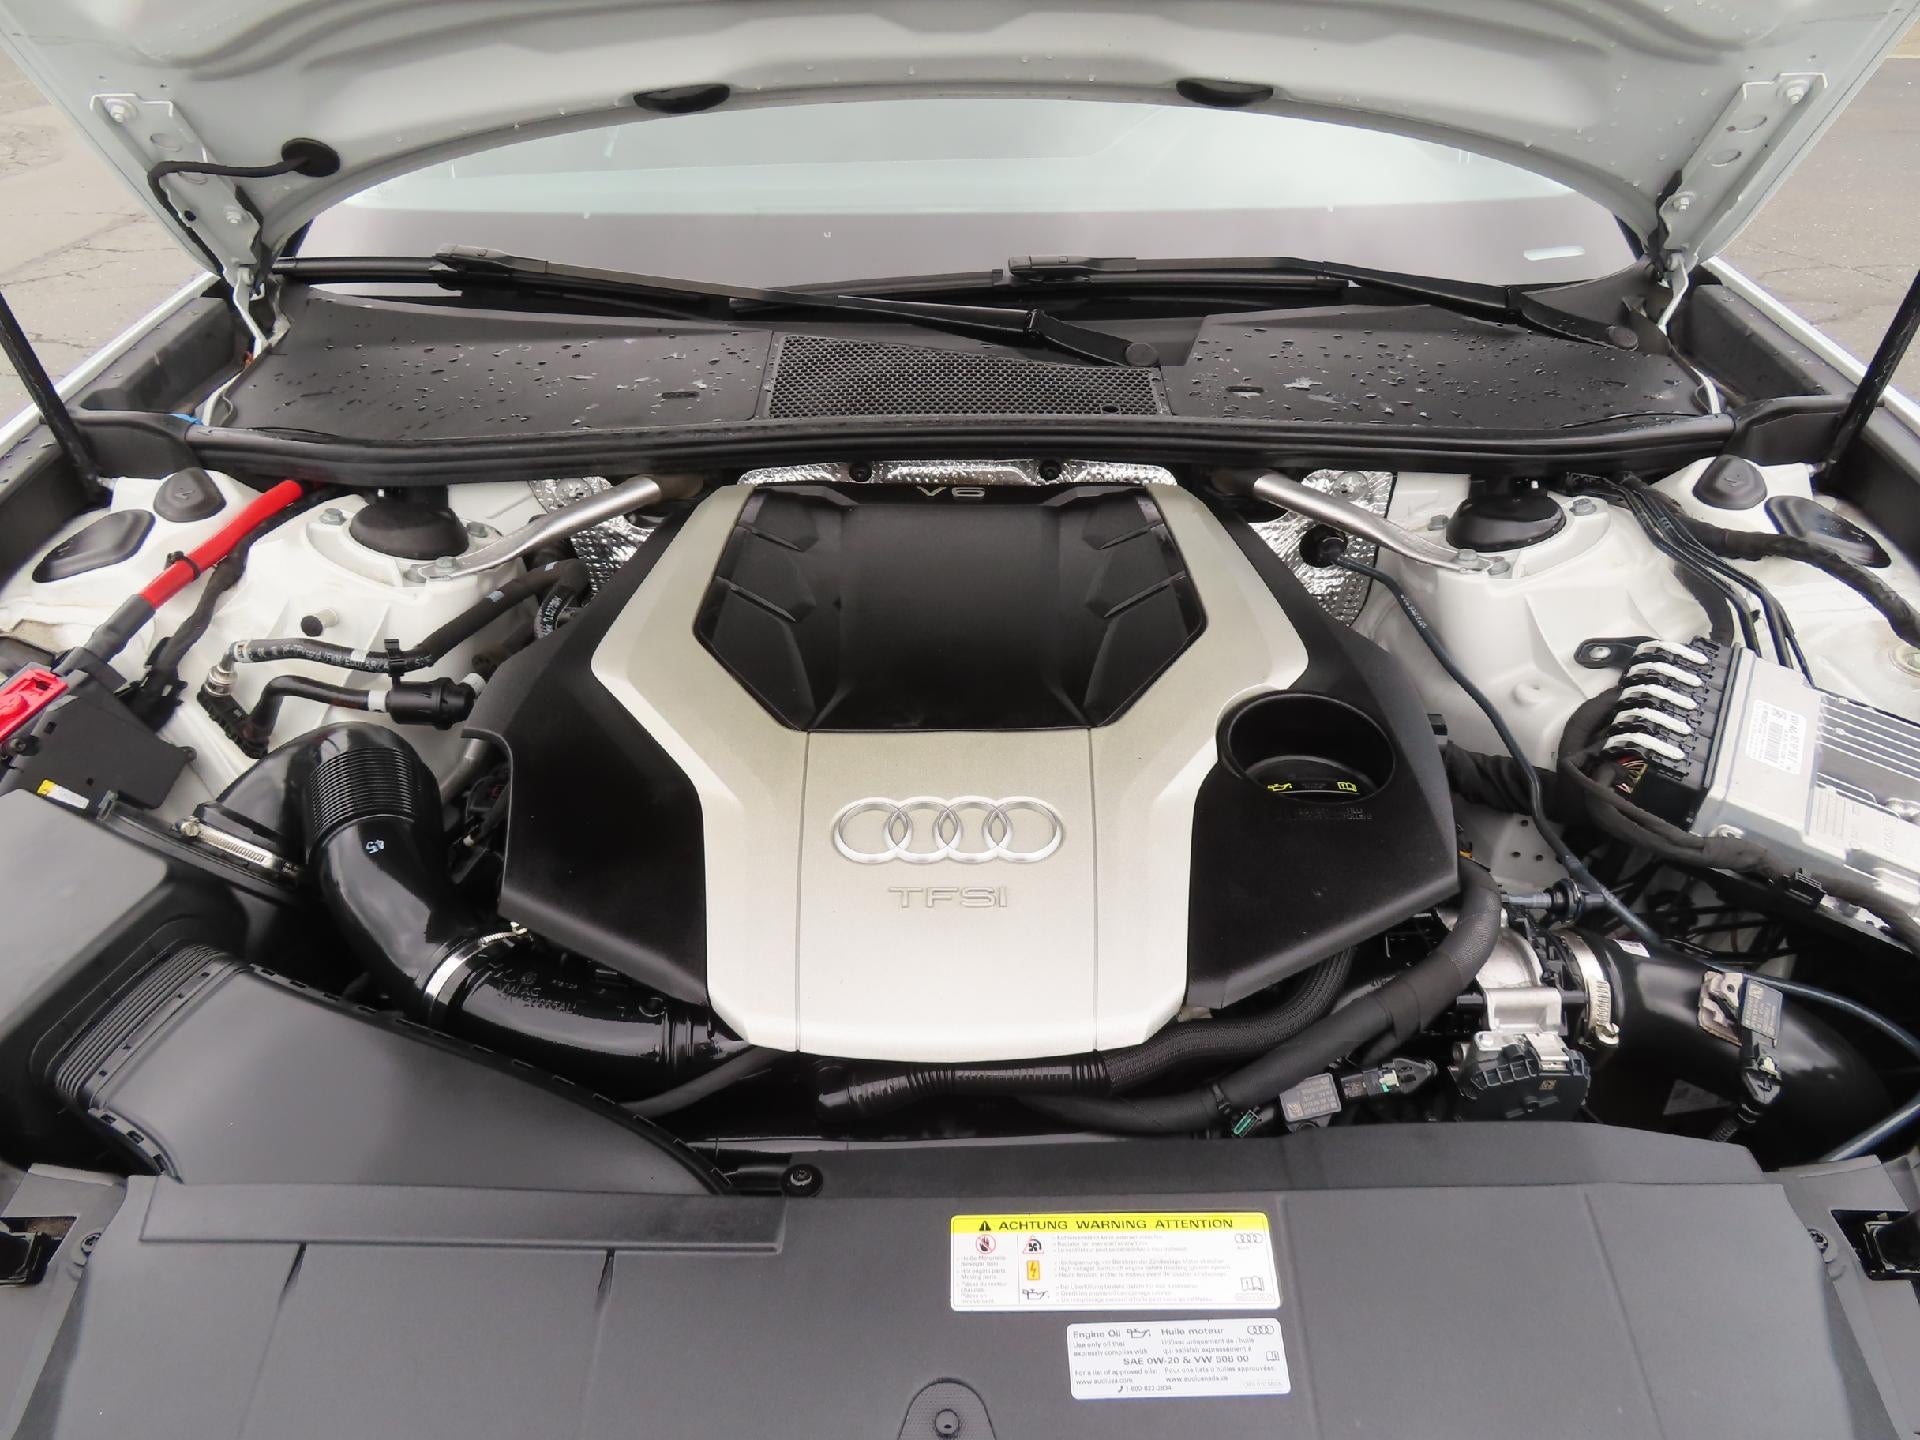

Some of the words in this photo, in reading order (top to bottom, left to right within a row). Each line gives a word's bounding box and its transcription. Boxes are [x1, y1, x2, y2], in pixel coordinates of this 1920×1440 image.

[916, 485, 985, 497] V6
[888, 885, 1008, 908] TFSI
[998, 1220, 1068, 1231] ACHTUNG
[1076, 1219, 1147, 1230] WARNING
[1155, 1218, 1234, 1229] ATTENTION
[1073, 1330, 1105, 1340] Engine
[1107, 1328, 1121, 1338] Oil
[1160, 1327, 1185, 1336] Huile
[1188, 1327, 1225, 1336] moteur
[1123, 1357, 1144, 1366] SAE
[1146, 1356, 1180, 1365] 0W-20
[1182, 1355, 1191, 1364] &
[1193, 1355, 1213, 1364] VW
[1236, 1354, 1249, 1363] 00
